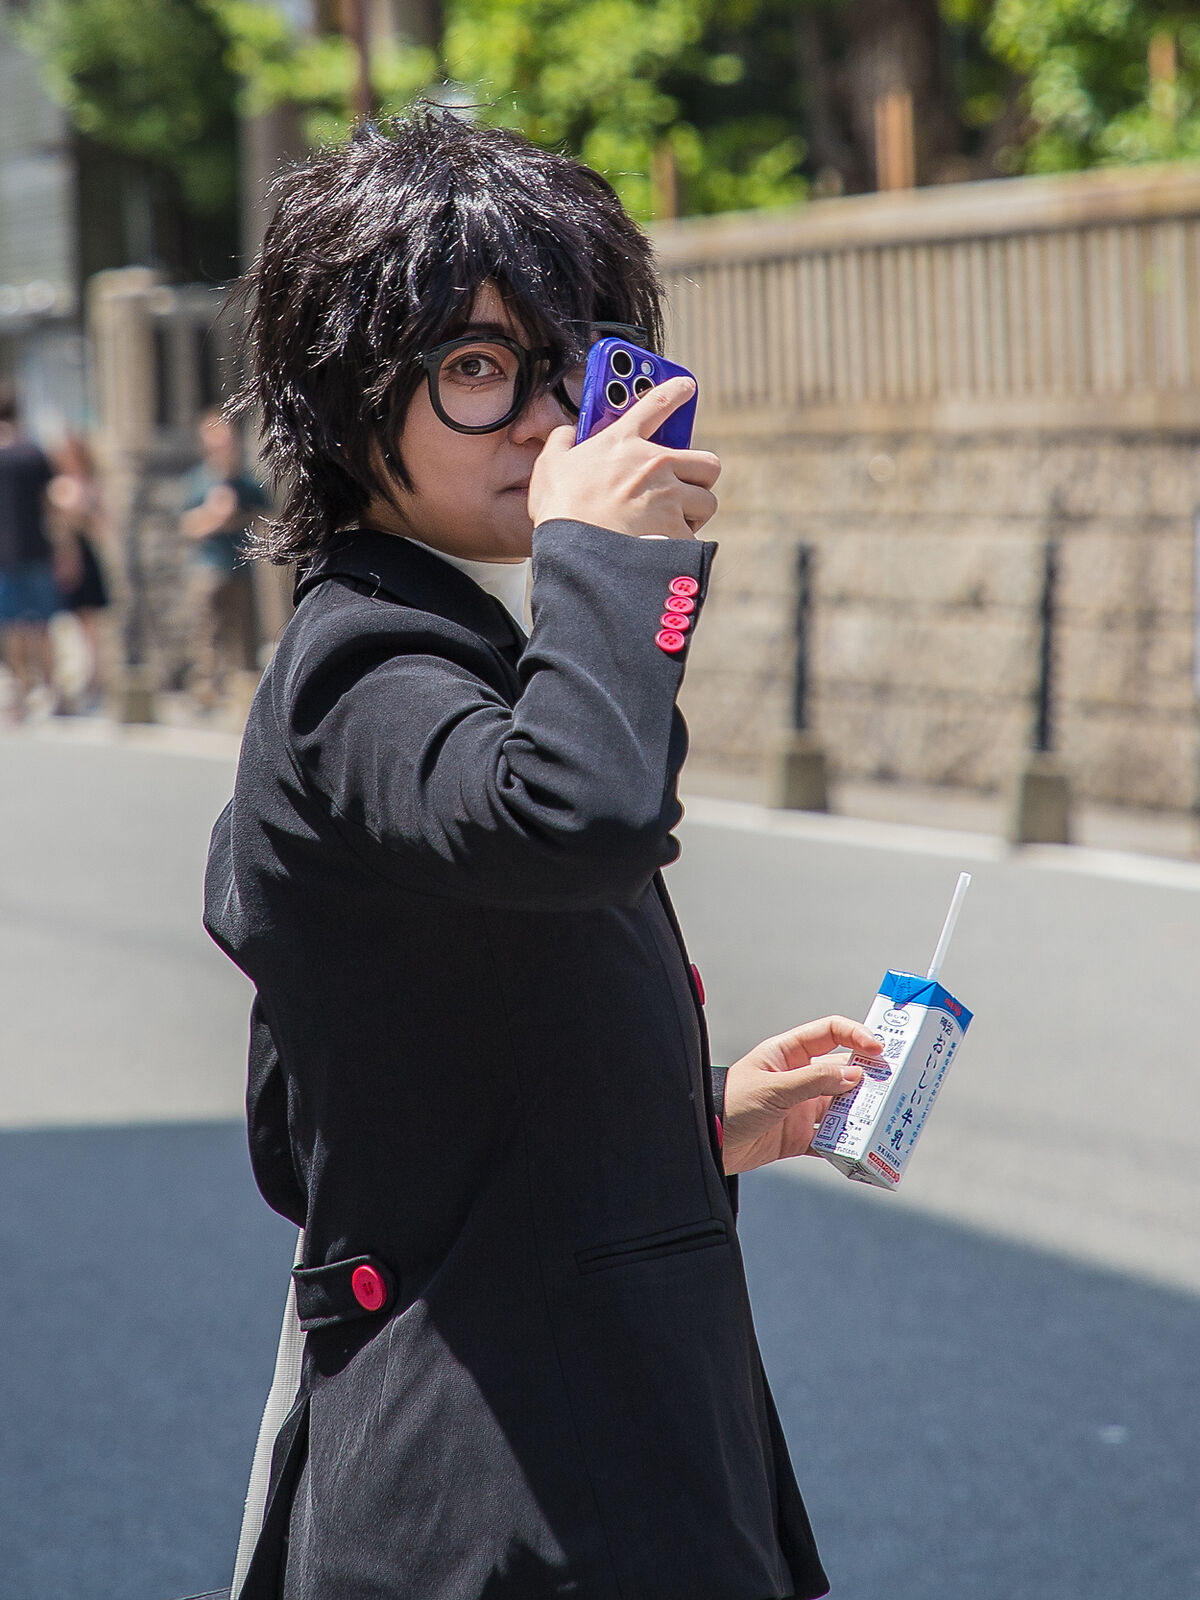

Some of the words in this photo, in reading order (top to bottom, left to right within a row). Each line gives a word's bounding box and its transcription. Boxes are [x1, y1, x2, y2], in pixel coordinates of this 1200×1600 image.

[890, 1033, 946, 1151] おいしい牛乳
